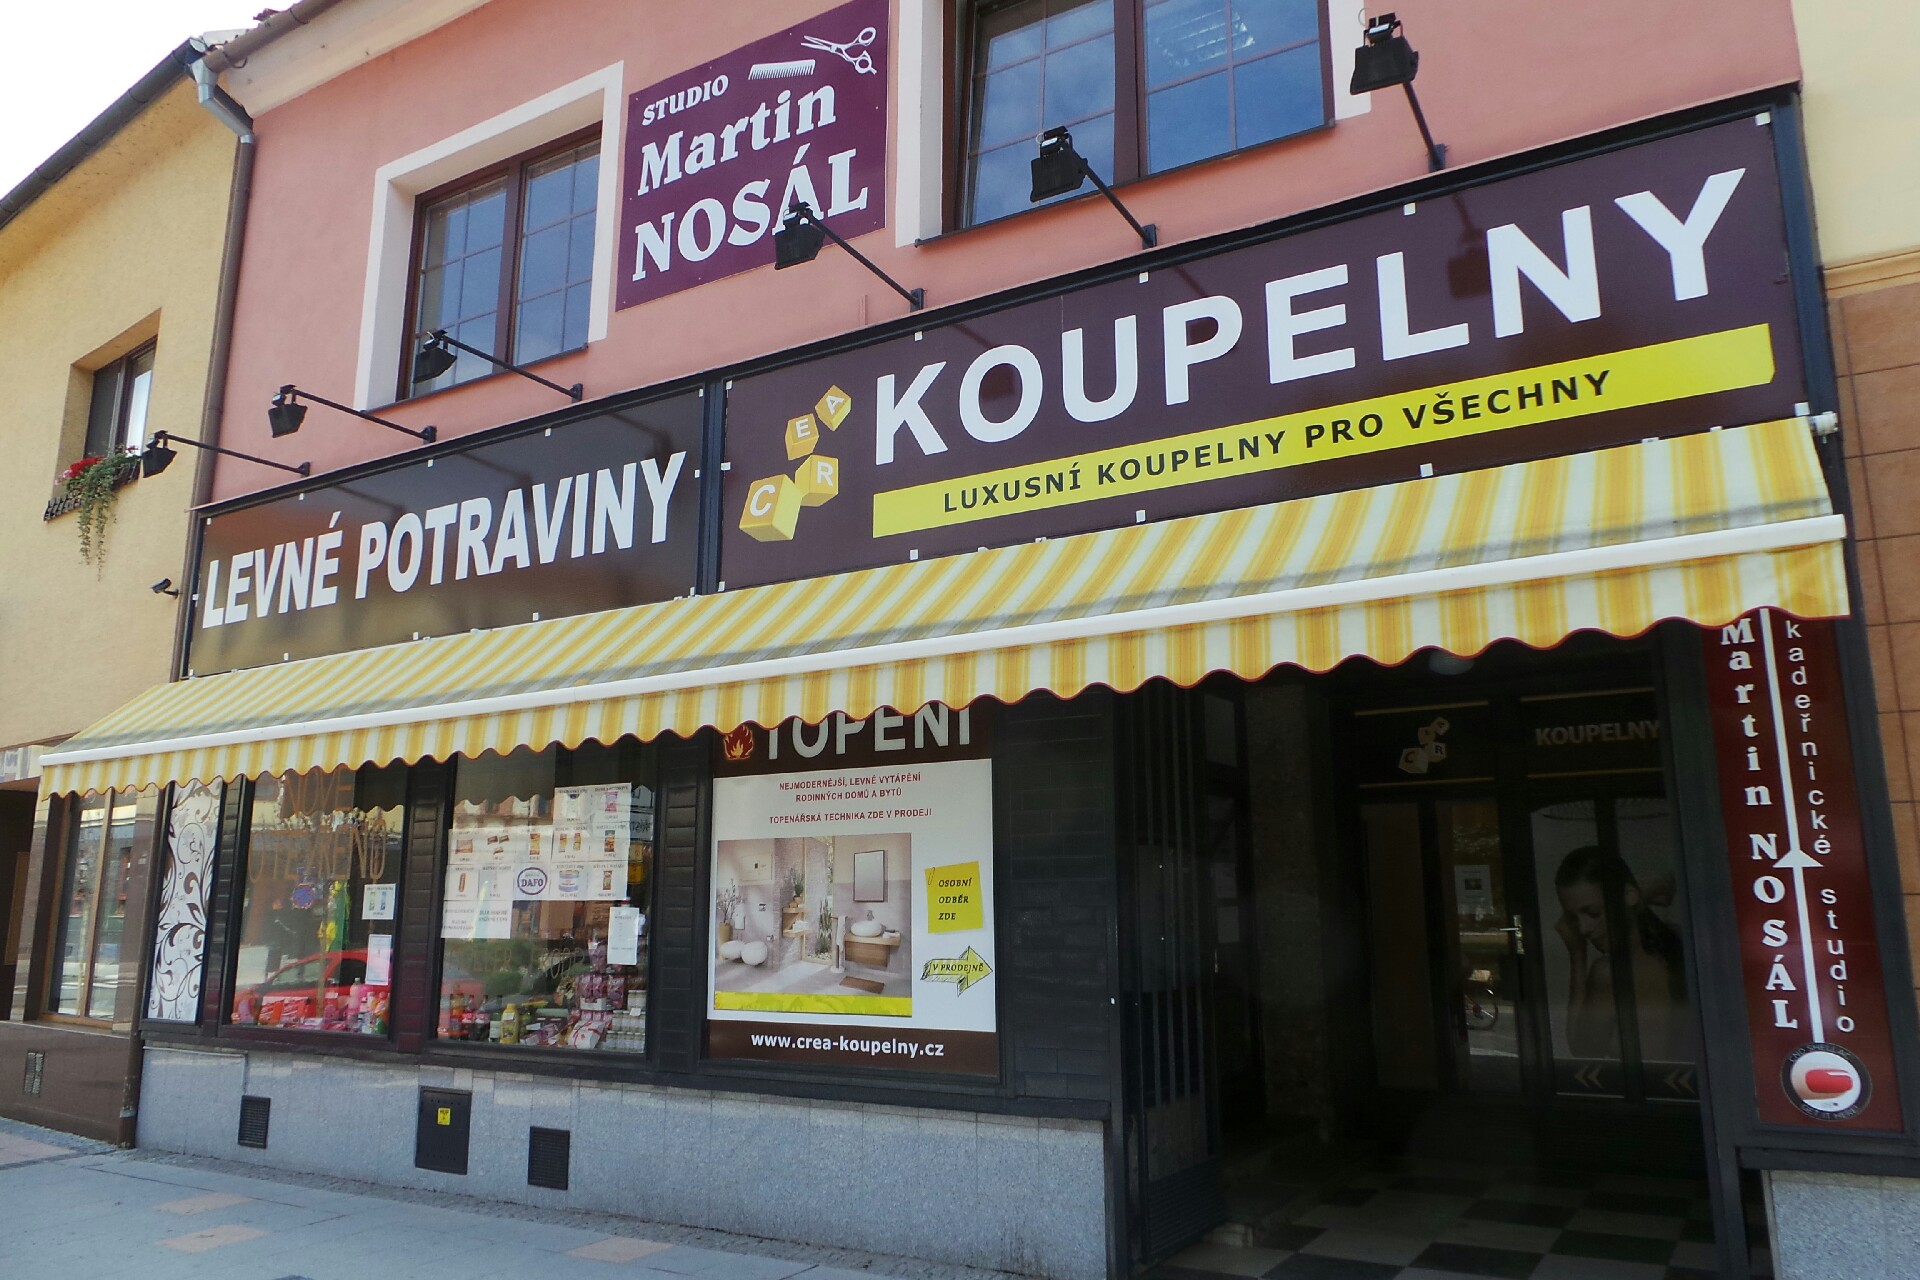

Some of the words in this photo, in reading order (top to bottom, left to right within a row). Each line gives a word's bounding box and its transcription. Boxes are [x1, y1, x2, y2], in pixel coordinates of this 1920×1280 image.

[642, 74, 729, 126] STUDIO
[637, 85, 836, 196] Martin
[632, 143, 868, 281] NOSÁL
[875, 167, 1746, 466] KOUPELNY
[943, 461, 1082, 513] LUXUSNÍ
[1097, 430, 1287, 486] KOUPELNY
[1304, 412, 1384, 450] PRO
[1402, 369, 1612, 430] VŠECHNY
[202, 510, 342, 629] LEVNÉ
[355, 451, 687, 600] POTRAVINY
[1535, 720, 1660, 746] KOUPELNY
[849, 774, 877, 786] LEVNÉ
[795, 790, 843, 802] RODINNÝCH
[871, 789, 877, 798] A
[824, 811, 865, 822] TECHNIKA
[867, 810, 884, 819] ZDE
[886, 810, 893, 818] V
[894, 808, 932, 818] PRODEJI
[1720, 617, 1772, 806] Martin
[1749, 833, 1798, 1029] NOSÁL
[521, 878, 544, 887] DAFO
[938, 877, 972, 887] OSOBNÍ
[938, 893, 969, 904] ODBĚR
[938, 912, 956, 920] ZDE
[932, 963, 938, 971] V
[940, 962, 984, 974] PRODEJNĚ
[1820, 888, 1855, 1032] studio
[751, 1033, 944, 1058] www.crea-koupelny.cz
